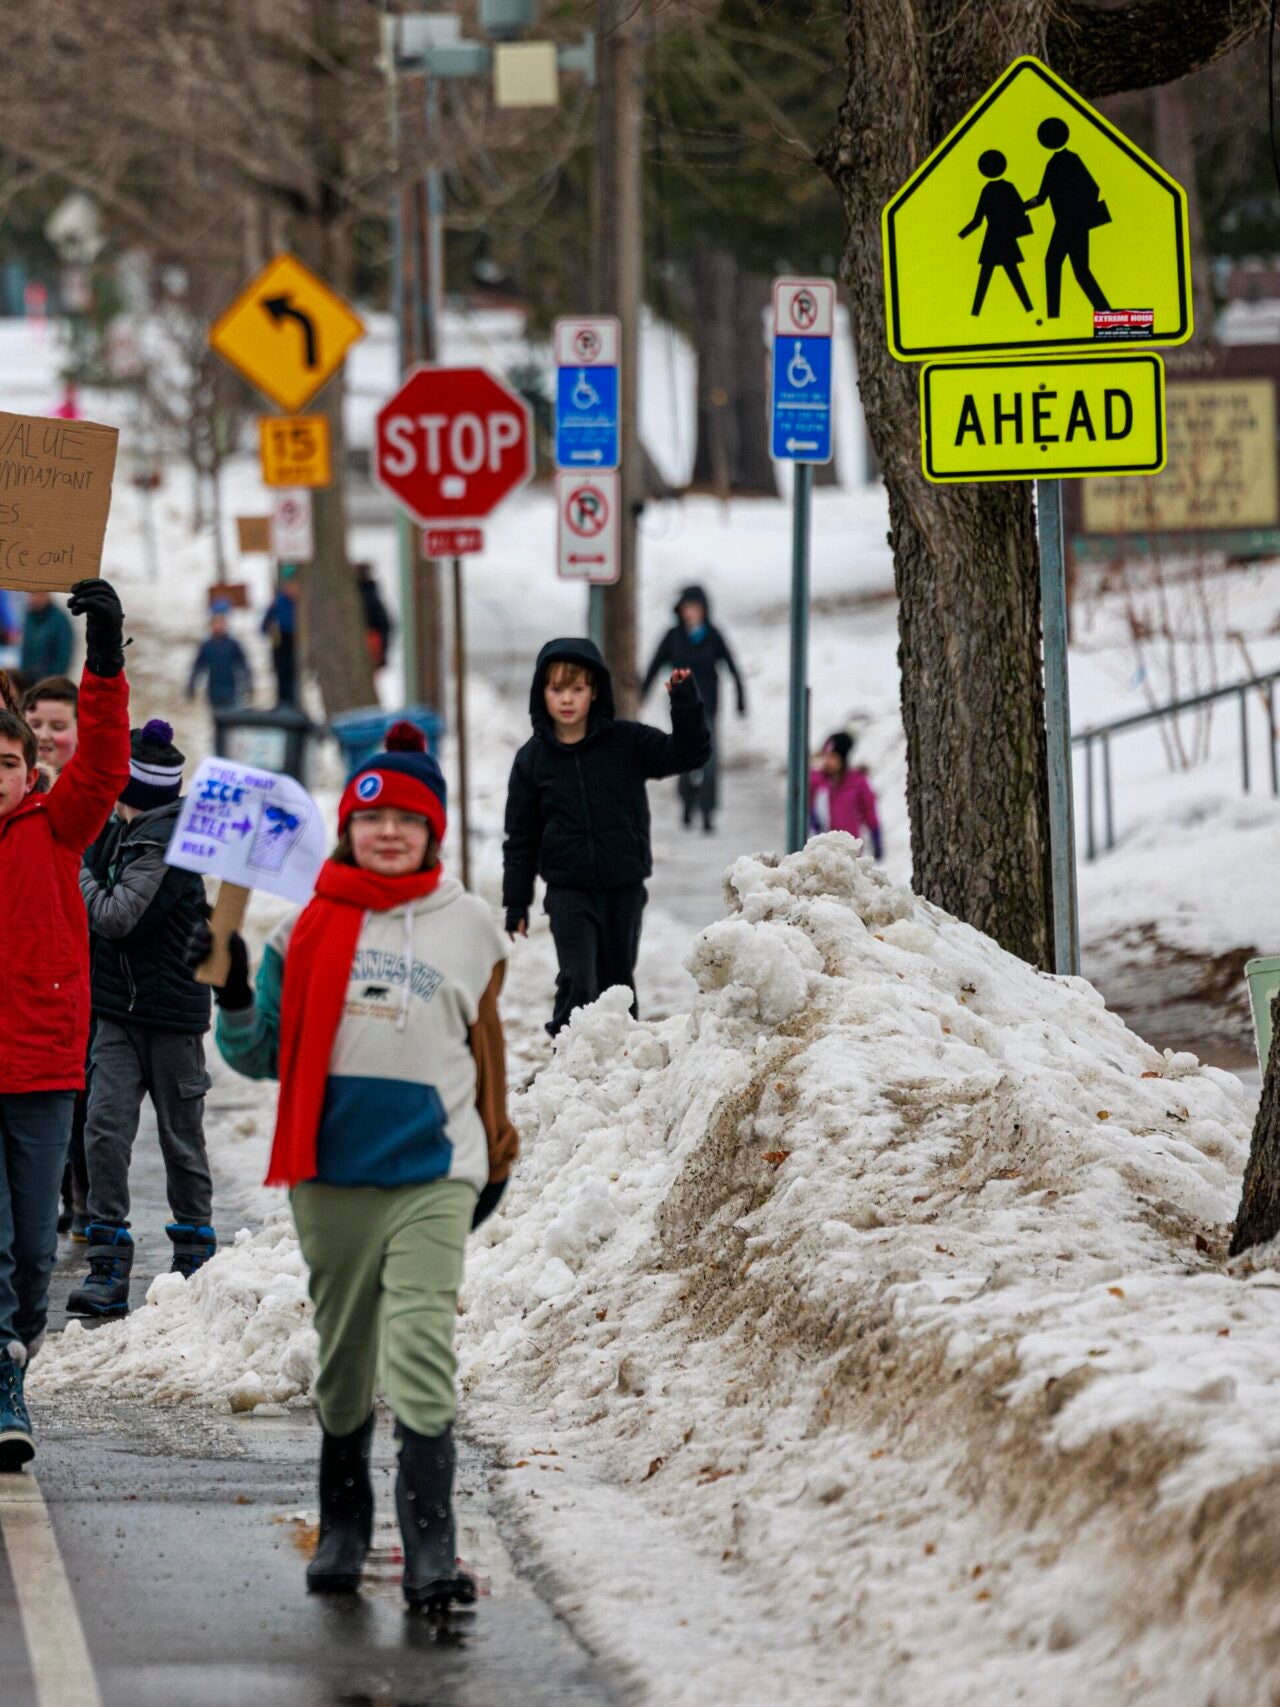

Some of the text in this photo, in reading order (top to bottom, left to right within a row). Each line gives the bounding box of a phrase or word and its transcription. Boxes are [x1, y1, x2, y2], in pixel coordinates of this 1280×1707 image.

[1094, 314, 1153, 323] EXTREME NOISE
[954, 389, 1133, 447] AHEAD
[272, 427, 317, 462] 15
[384, 412, 521, 477] STOP
